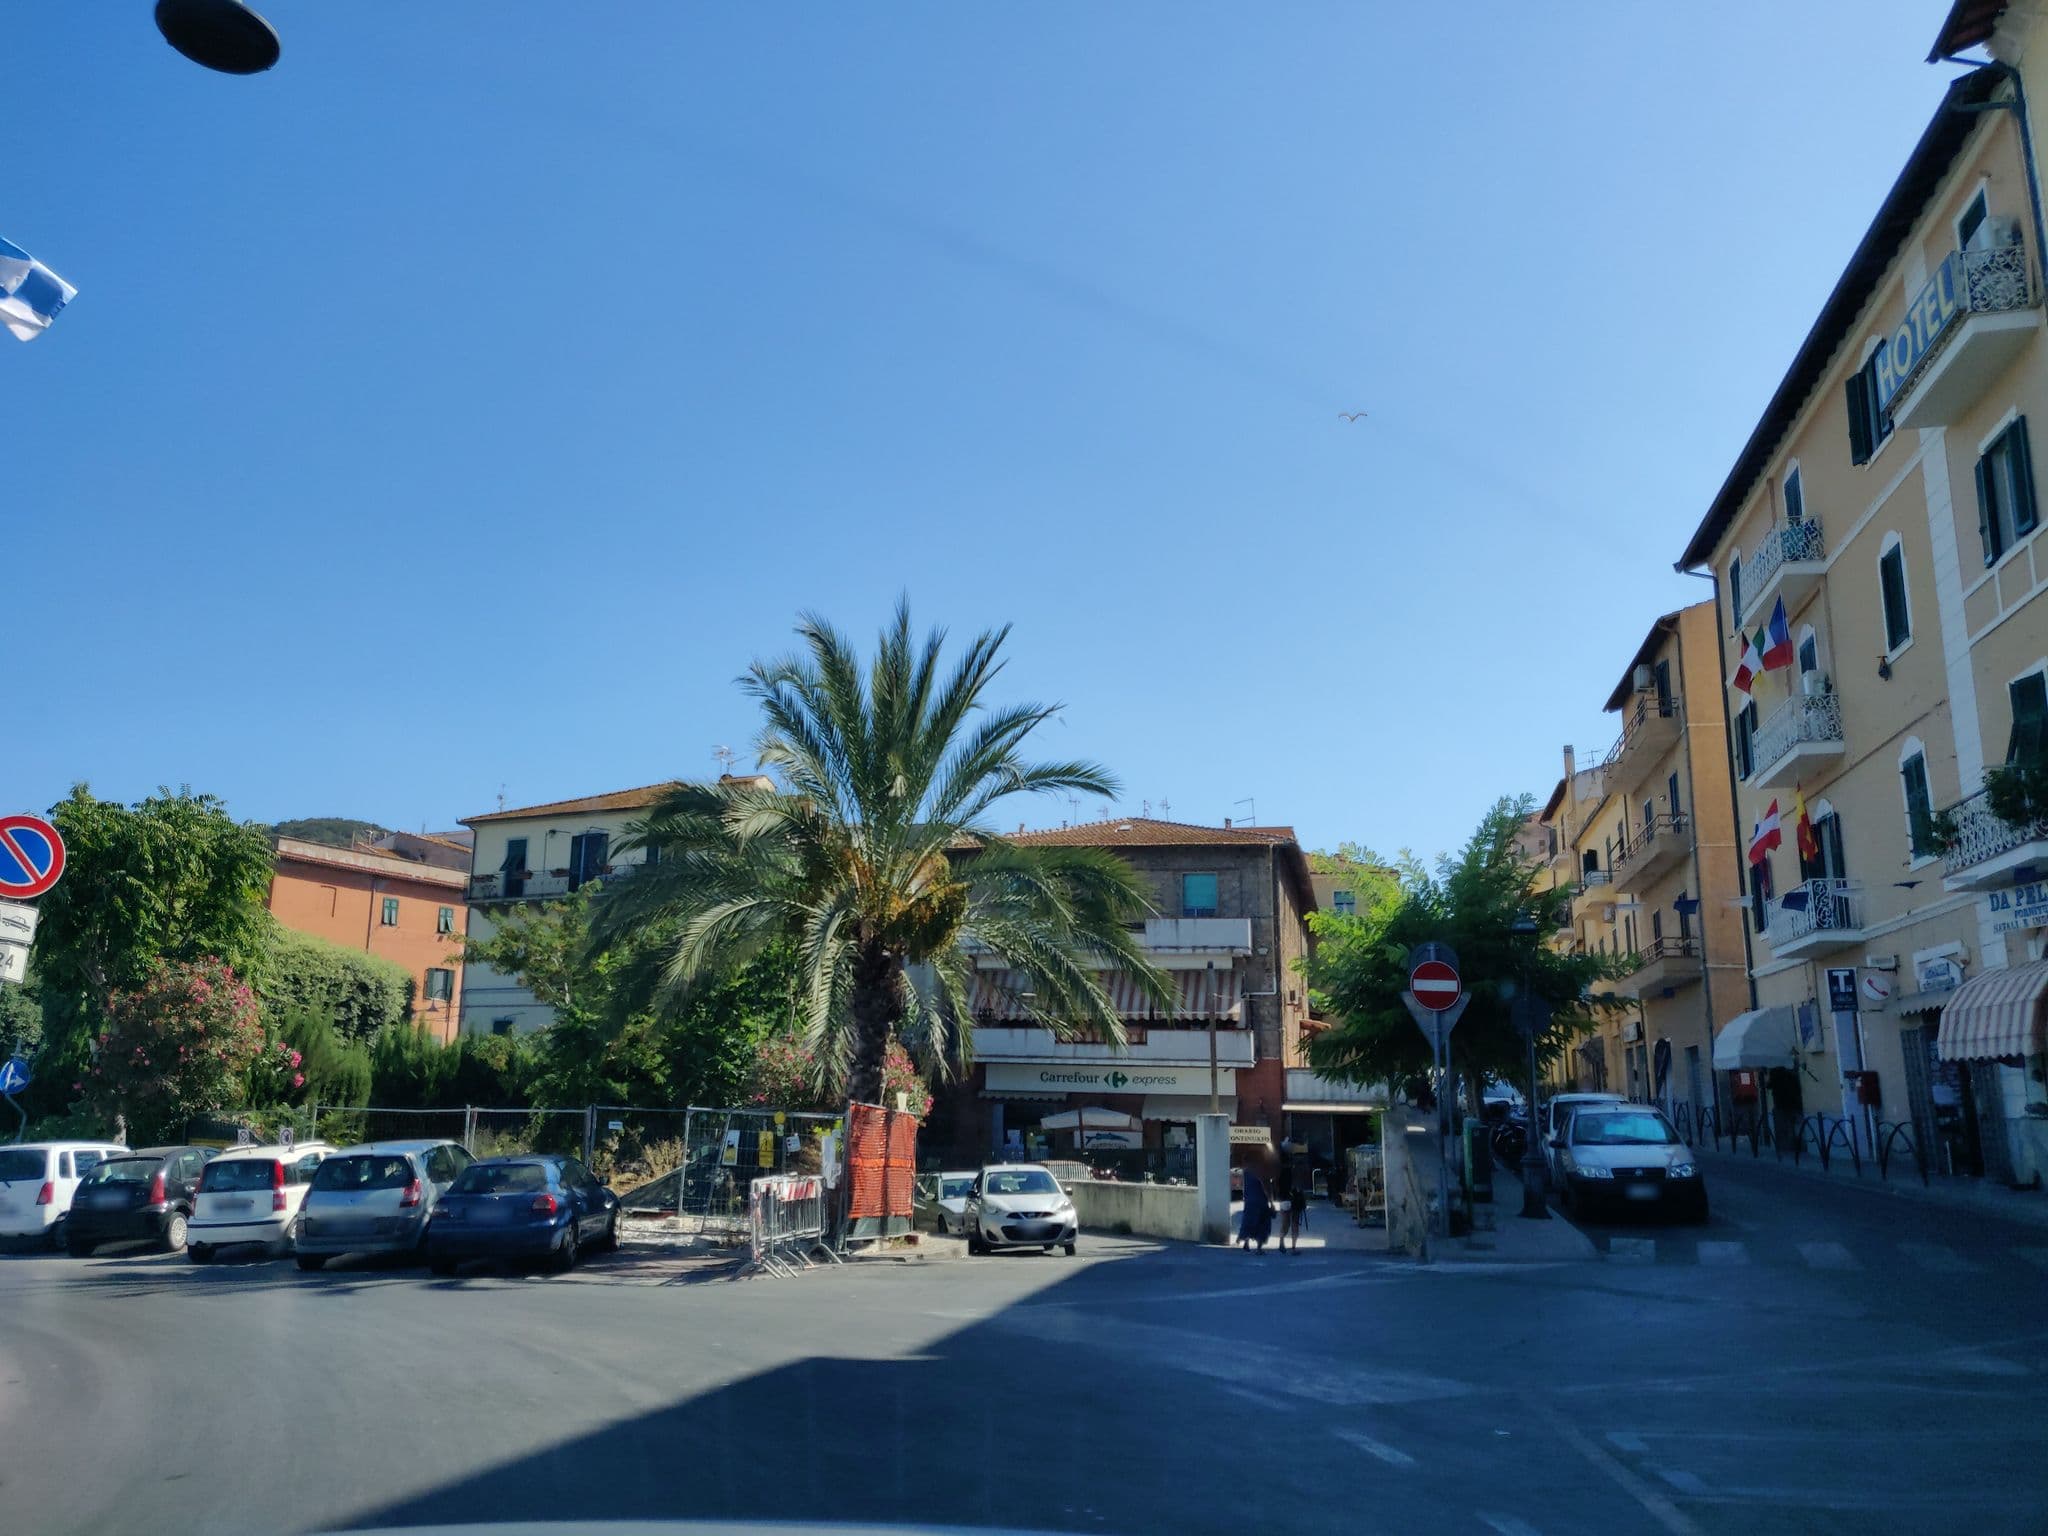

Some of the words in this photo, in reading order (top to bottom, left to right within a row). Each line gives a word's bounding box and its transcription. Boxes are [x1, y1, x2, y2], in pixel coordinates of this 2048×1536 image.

[1877, 271, 1954, 404] HOTEL
[1989, 891, 2011, 912] DA
[1040, 1071, 1099, 1084] Carrefour
[1132, 1075, 1177, 1087] express
